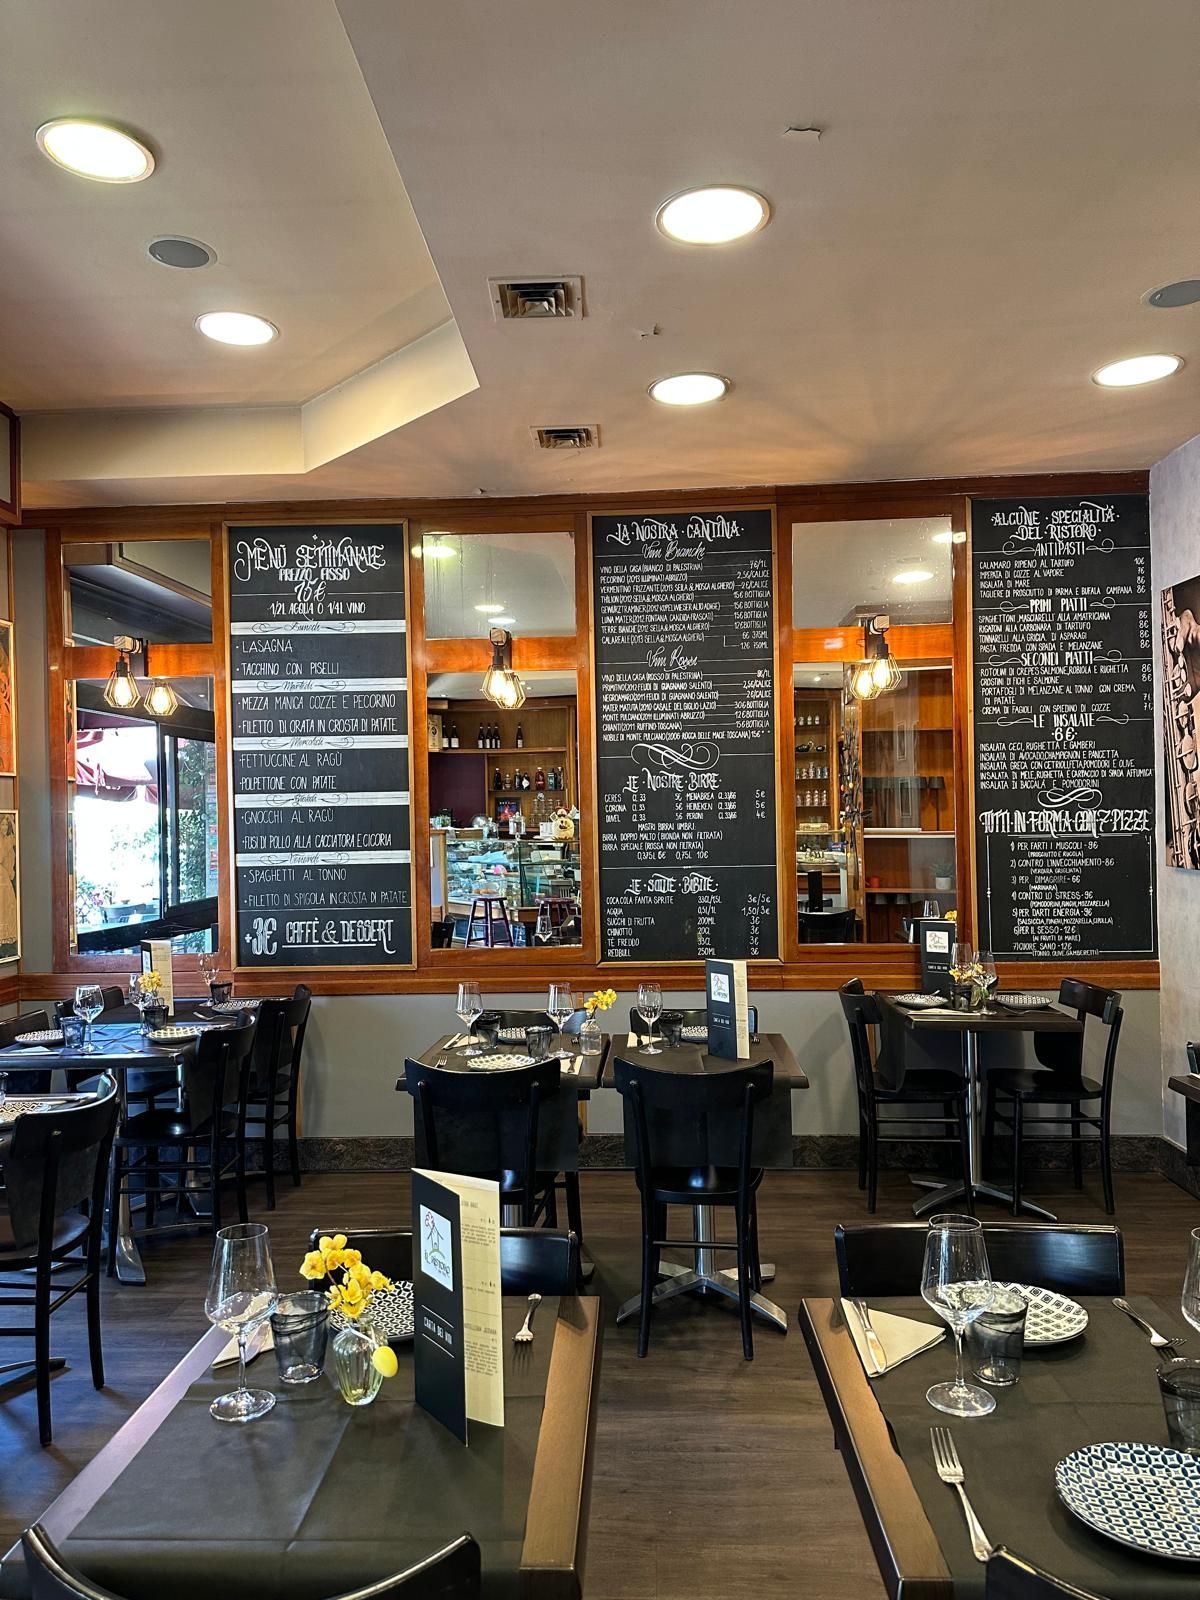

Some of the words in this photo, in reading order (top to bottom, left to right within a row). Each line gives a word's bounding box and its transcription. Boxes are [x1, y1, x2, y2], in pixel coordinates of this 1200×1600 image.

[993, 506, 1040, 526] ALCUNE
[1051, 501, 1115, 524] SPECIALITÀ
[631, 519, 679, 541] NOSTRA
[686, 515, 740, 541] CANTINA
[1009, 525, 1043, 540] DEL
[1046, 522, 1097, 542] RISTORO
[295, 537, 386, 573] SETTIMANALE
[1034, 541, 1085, 556] ANTIPASTI
[980, 560, 1011, 569] CALAMARO
[1015, 559, 1037, 569] RIPIENO
[1040, 559, 1048, 568] AL
[1051, 558, 1074, 567] TARTUFO
[1134, 557, 1145, 565] 10€
[279, 568, 312, 581] PREZZO
[321, 568, 350, 580] FISSO
[980, 579, 1003, 588] INSALATA
[1007, 579, 1012, 587] DI
[1015, 579, 1030, 587] MARE
[1137, 576, 1145, 584] 8€
[317, 603, 324, 614] O
[347, 602, 366, 614] VINO
[1030, 598, 1051, 613] PRIMI
[1061, 597, 1087, 612] PIATTI
[242, 639, 293, 653] LASAGNA
[1021, 652, 1059, 667] SECONDI
[1065, 650, 1093, 665] PIATTI
[242, 663, 279, 676] TACCHINO
[286, 663, 302, 675] CON
[310, 662, 339, 675] PISELLI
[602, 674, 614, 682] VINO
[616, 673, 631, 682] DELLA
[633, 673, 645, 681] CASA
[981, 677, 1004, 687] CROSTINI
[1006, 678, 1012, 686] DI
[1013, 677, 1025, 686] FICHI
[1027, 677, 1030, 685] E
[1034, 676, 1060, 685] SALMONE
[1142, 673, 1152, 682] 8€
[242, 696, 269, 711] MEZZA
[274, 696, 303, 710] MANICA
[309, 695, 337, 709] COZZE
[343, 695, 349, 709] E
[353, 693, 395, 709] PECORINO
[242, 720, 273, 734] FILETTO
[279, 720, 287, 733] DI
[289, 719, 315, 733] ORATA
[318, 719, 326, 732] IN
[328, 718, 359, 732] CROSTA
[361, 718, 368, 732] DI
[371, 718, 397, 732] PATATE
[1034, 714, 1045, 728] LE
[1053, 713, 1096, 727] INSALATE
[980, 743, 1006, 752] INSALATA
[1026, 741, 1060, 750] RUGHETTA
[1064, 741, 1067, 749] E
[1069, 741, 1095, 749] GAMBERI
[241, 753, 296, 768] FETTUCCINE
[300, 753, 310, 766] AL
[317, 751, 342, 767] RAGÙ
[241, 776, 285, 790] POLPETTONE
[291, 776, 307, 789] CON
[312, 775, 337, 789] PATATE
[642, 768, 684, 792] NOSTRE
[688, 772, 719, 790] BIRRE
[980, 780, 1008, 789] INSALATA
[1012, 780, 1018, 789] DI
[1053, 780, 1056, 788] E
[1062, 779, 1099, 788] POMODORINI
[245, 810, 283, 824] GNOCCHI
[291, 810, 304, 823] AL
[309, 808, 333, 822] RAGÙ
[979, 809, 1011, 834] TUTTI
[1014, 810, 1026, 832] IN
[1028, 809, 1073, 838] FORMA
[1111, 808, 1152, 831] PIZZE
[260, 835, 267, 849] DI
[269, 835, 290, 849] POLLO
[293, 835, 311, 848] ALLA
[315, 834, 355, 848] CACCIATORA
[357, 834, 362, 848] E
[363, 834, 392, 847] CICORIA
[603, 833, 617, 841] BIRRA
[620, 833, 637, 841] DOPPIO
[639, 832, 656, 840] MALTO
[682, 832, 693, 840] NON
[697, 831, 722, 840] FILTRATA)
[249, 868, 295, 883] SPAGHETTI
[303, 869, 314, 881] AL
[317, 868, 346, 881] TONNO
[681, 872, 717, 894] BIBITE
[249, 894, 279, 907] FILETTO
[284, 894, 290, 906] DI
[294, 893, 325, 906] SPIGOLA
[330, 893, 337, 905] IN
[338, 891, 367, 904] CROSTA
[370, 891, 376, 903] DI
[381, 890, 407, 904] PATATE
[607, 917, 626, 926] SUCCHI
[628, 917, 633, 926] DI
[634, 916, 655, 926] FRUTTA
[697, 917, 716, 925] 200ML
[751, 916, 760, 924] 3€
[286, 917, 319, 943] CAFFÈ
[321, 920, 339, 944] &
[339, 919, 396, 954] DESSERT
[607, 928, 633, 936] CHINOTTO
[751, 926, 760, 934] 3€
[618, 938, 639, 947] FREDDO
[750, 937, 759, 945] 3€
[751, 947, 759, 955] 3€
[424, 1316, 435, 1333] CARTA
